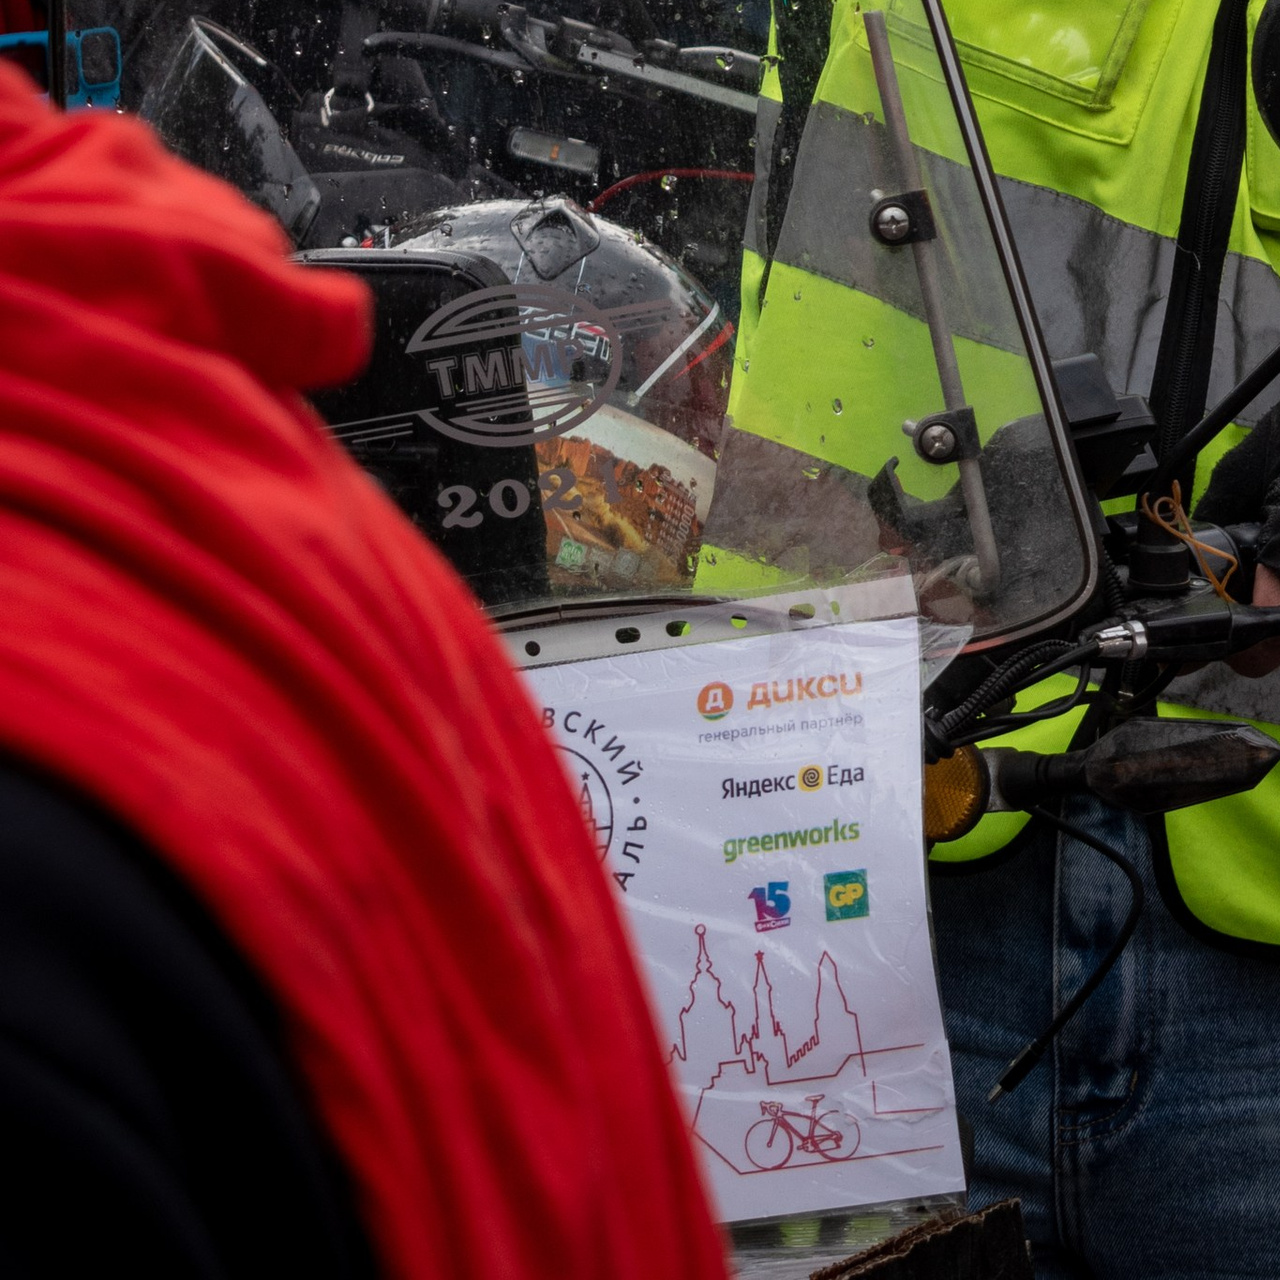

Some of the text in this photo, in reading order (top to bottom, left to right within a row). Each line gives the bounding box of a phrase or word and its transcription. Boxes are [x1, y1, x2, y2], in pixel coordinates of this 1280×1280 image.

[698, 713, 864, 743] генеральный партнёр
[721, 764, 866, 800] Яндекс Еда
[723, 817, 861, 864] greenworks
[747, 880, 792, 922] 15
[828, 881, 865, 909] GP
